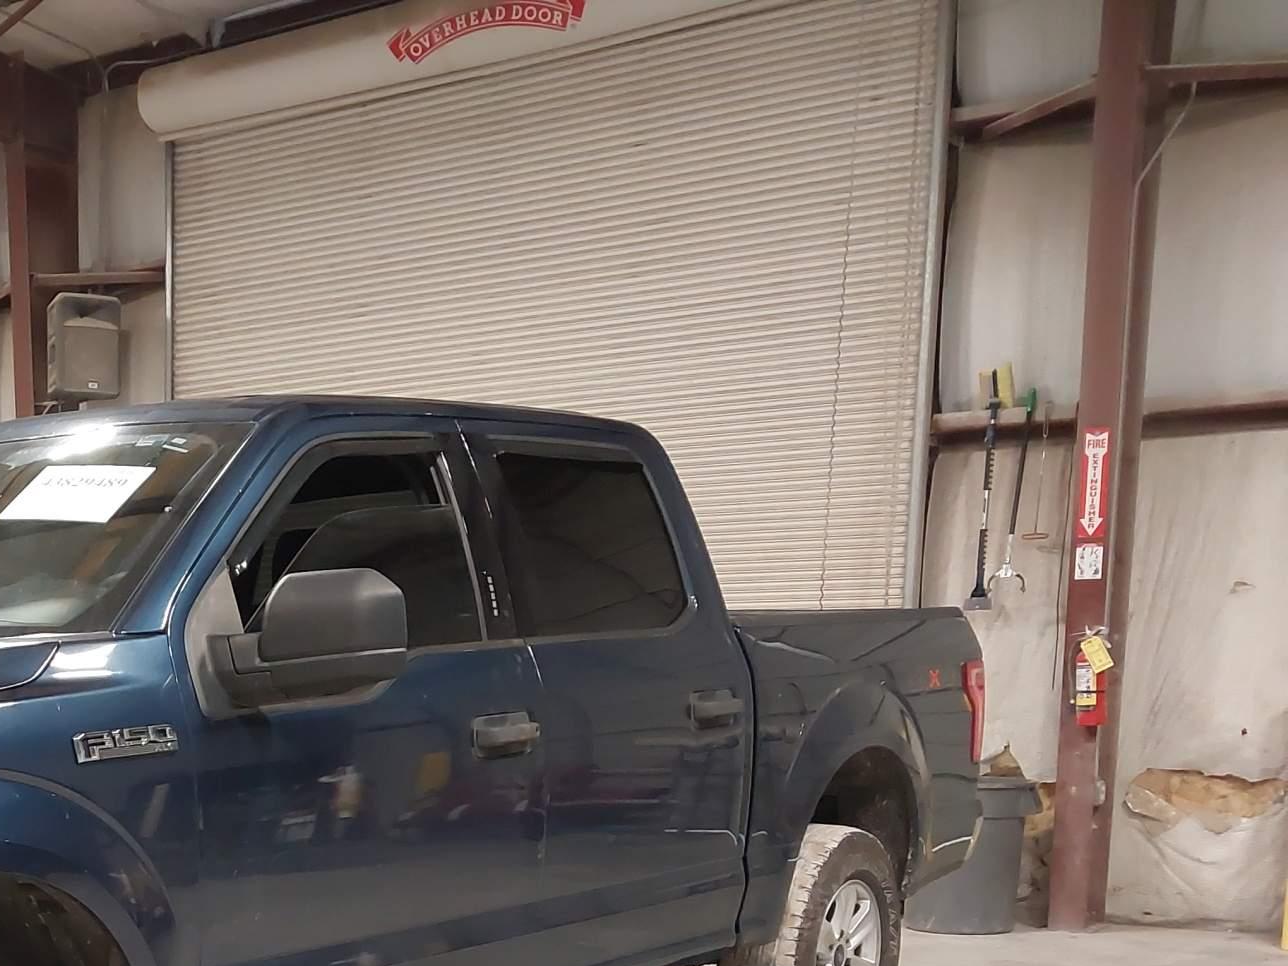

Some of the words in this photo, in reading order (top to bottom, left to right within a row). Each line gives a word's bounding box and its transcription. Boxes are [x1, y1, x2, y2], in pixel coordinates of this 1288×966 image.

[410, 5, 506, 56] OVERHEAD
[510, 5, 564, 26] DOOR
[1087, 438, 1107, 450] FIRE
[1087, 453, 1100, 530] EXTINGUISHER
